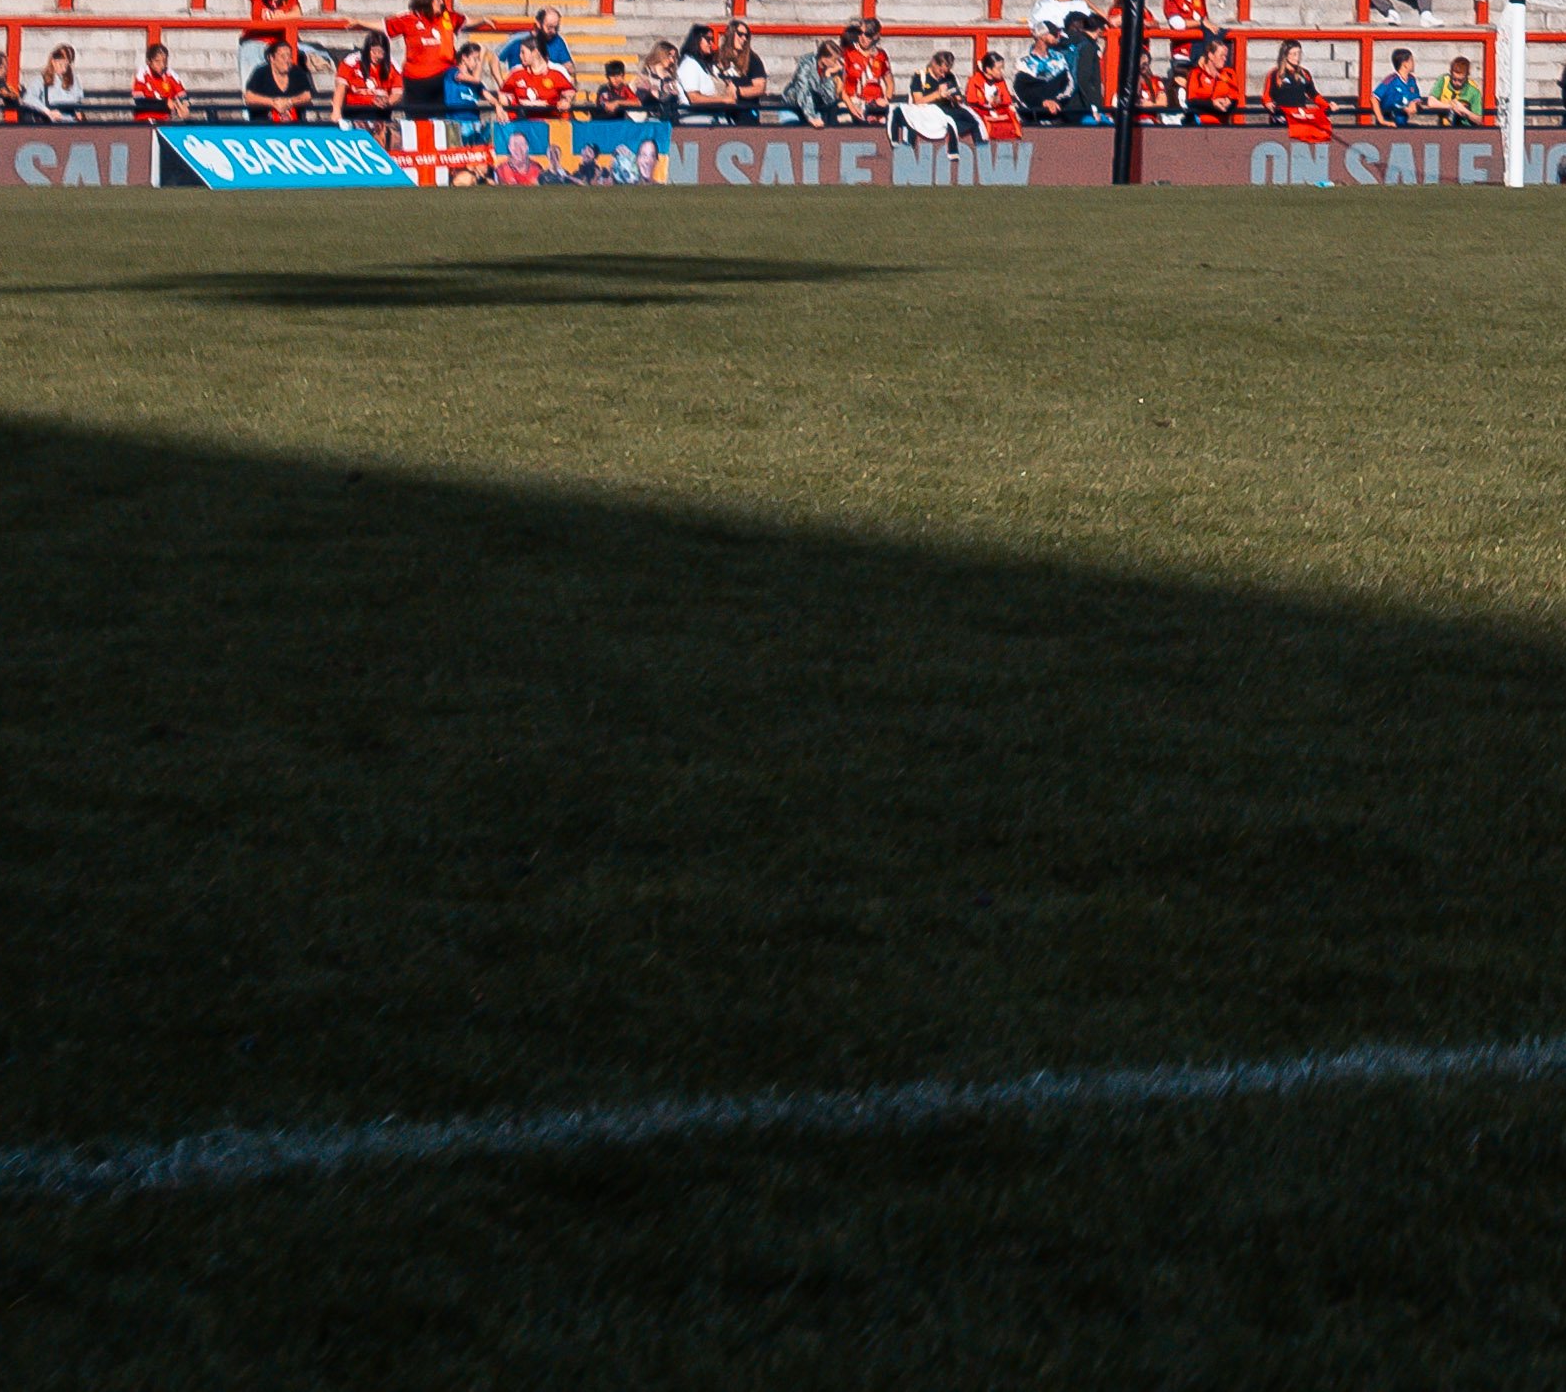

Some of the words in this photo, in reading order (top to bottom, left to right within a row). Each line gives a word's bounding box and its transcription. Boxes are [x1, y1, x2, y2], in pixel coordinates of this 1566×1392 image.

[14, 141, 129, 186] SAL
[222, 138, 393, 176] BARCLAYS
[716, 140, 878, 186] SALE
[892, 141, 1033, 186] NOW
[1250, 141, 1329, 185] ON
[1344, 141, 1492, 186] SALE
